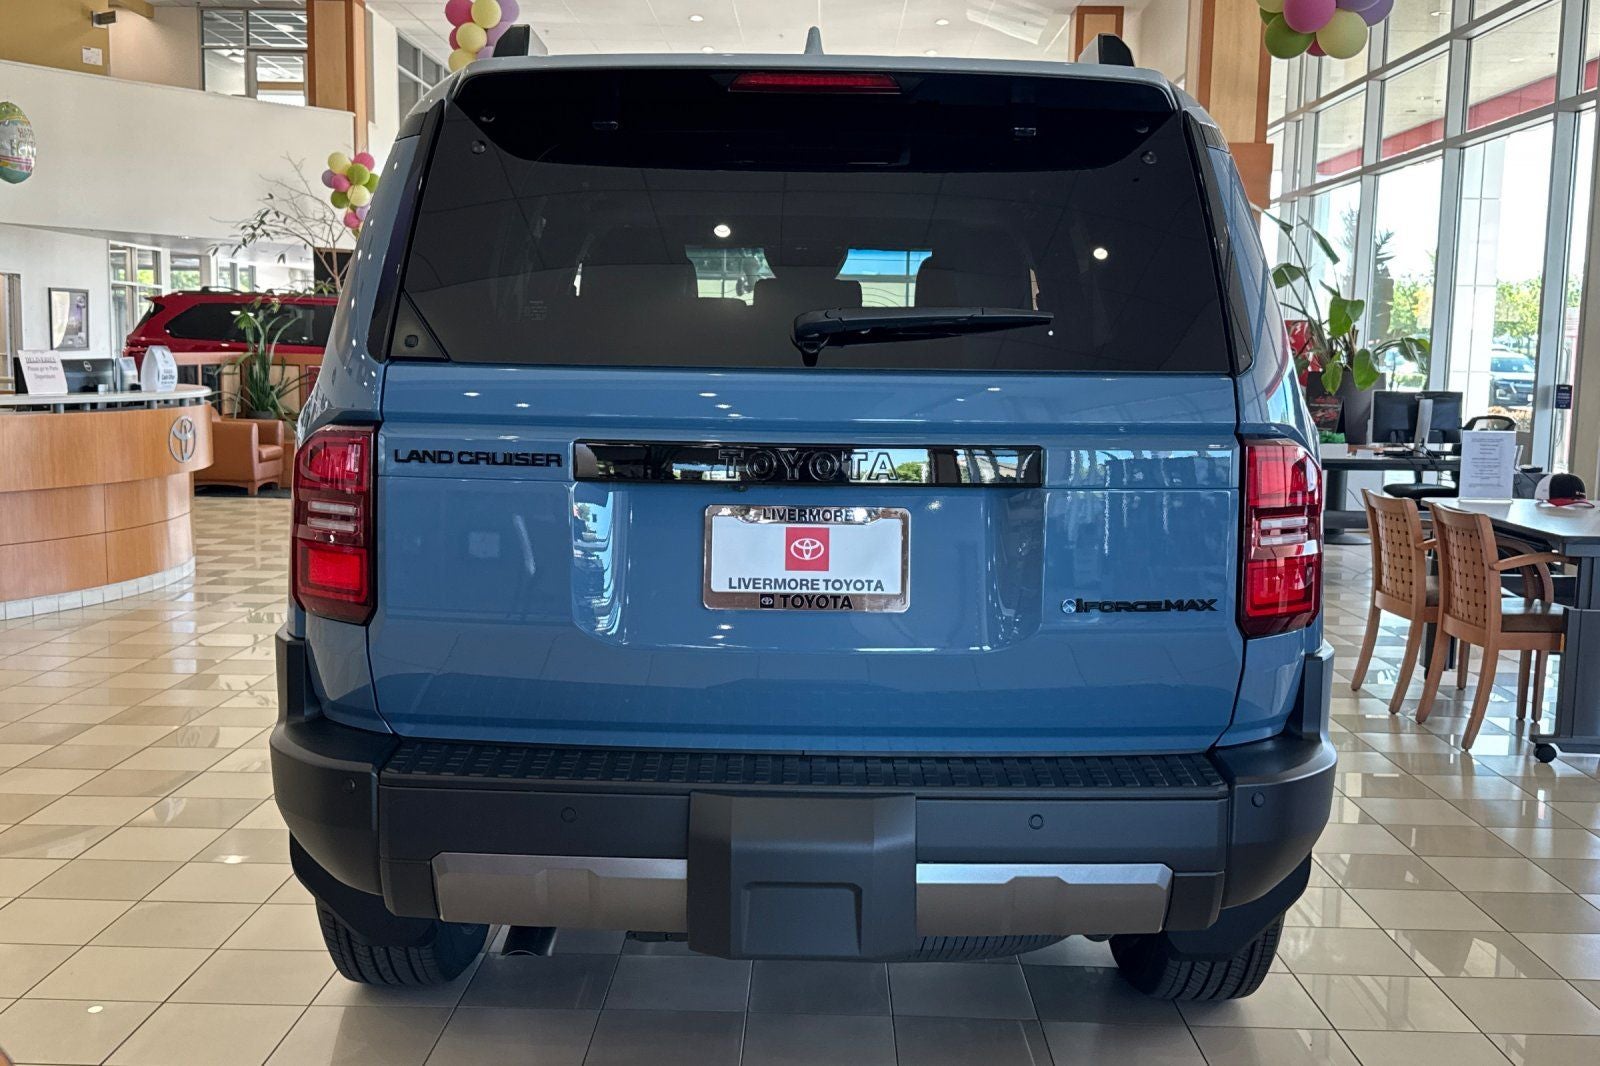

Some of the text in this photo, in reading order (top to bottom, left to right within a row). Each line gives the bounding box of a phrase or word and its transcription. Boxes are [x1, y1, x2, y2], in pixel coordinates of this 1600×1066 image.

[394, 449, 562, 468] LAND CRUISER
[718, 449, 899, 481] TOYOTA
[762, 508, 855, 522] LIVERMORE
[728, 577, 885, 592] LIVERMORE TOYOTA
[780, 594, 853, 610] TOYOTA
